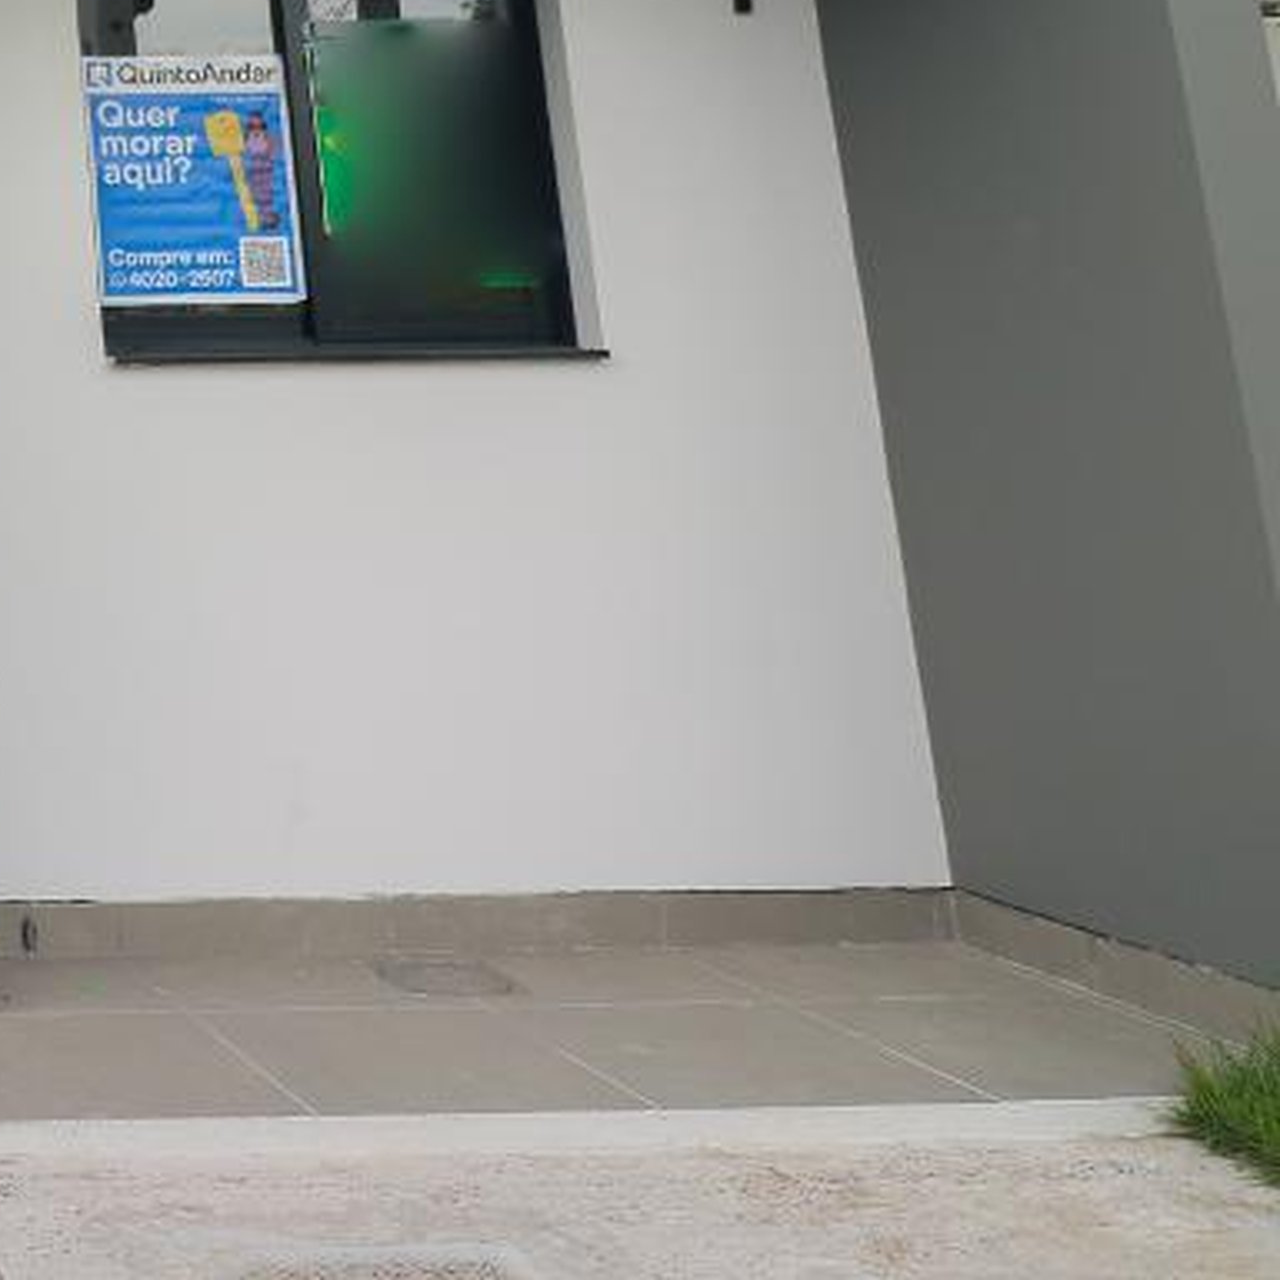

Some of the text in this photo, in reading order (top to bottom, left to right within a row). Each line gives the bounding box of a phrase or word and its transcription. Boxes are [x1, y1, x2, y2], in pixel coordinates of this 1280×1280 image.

[97, 101, 181, 129] Quer
[101, 133, 197, 157] morar
[103, 156, 191, 190] aqui?
[108, 248, 191, 269] Compre
